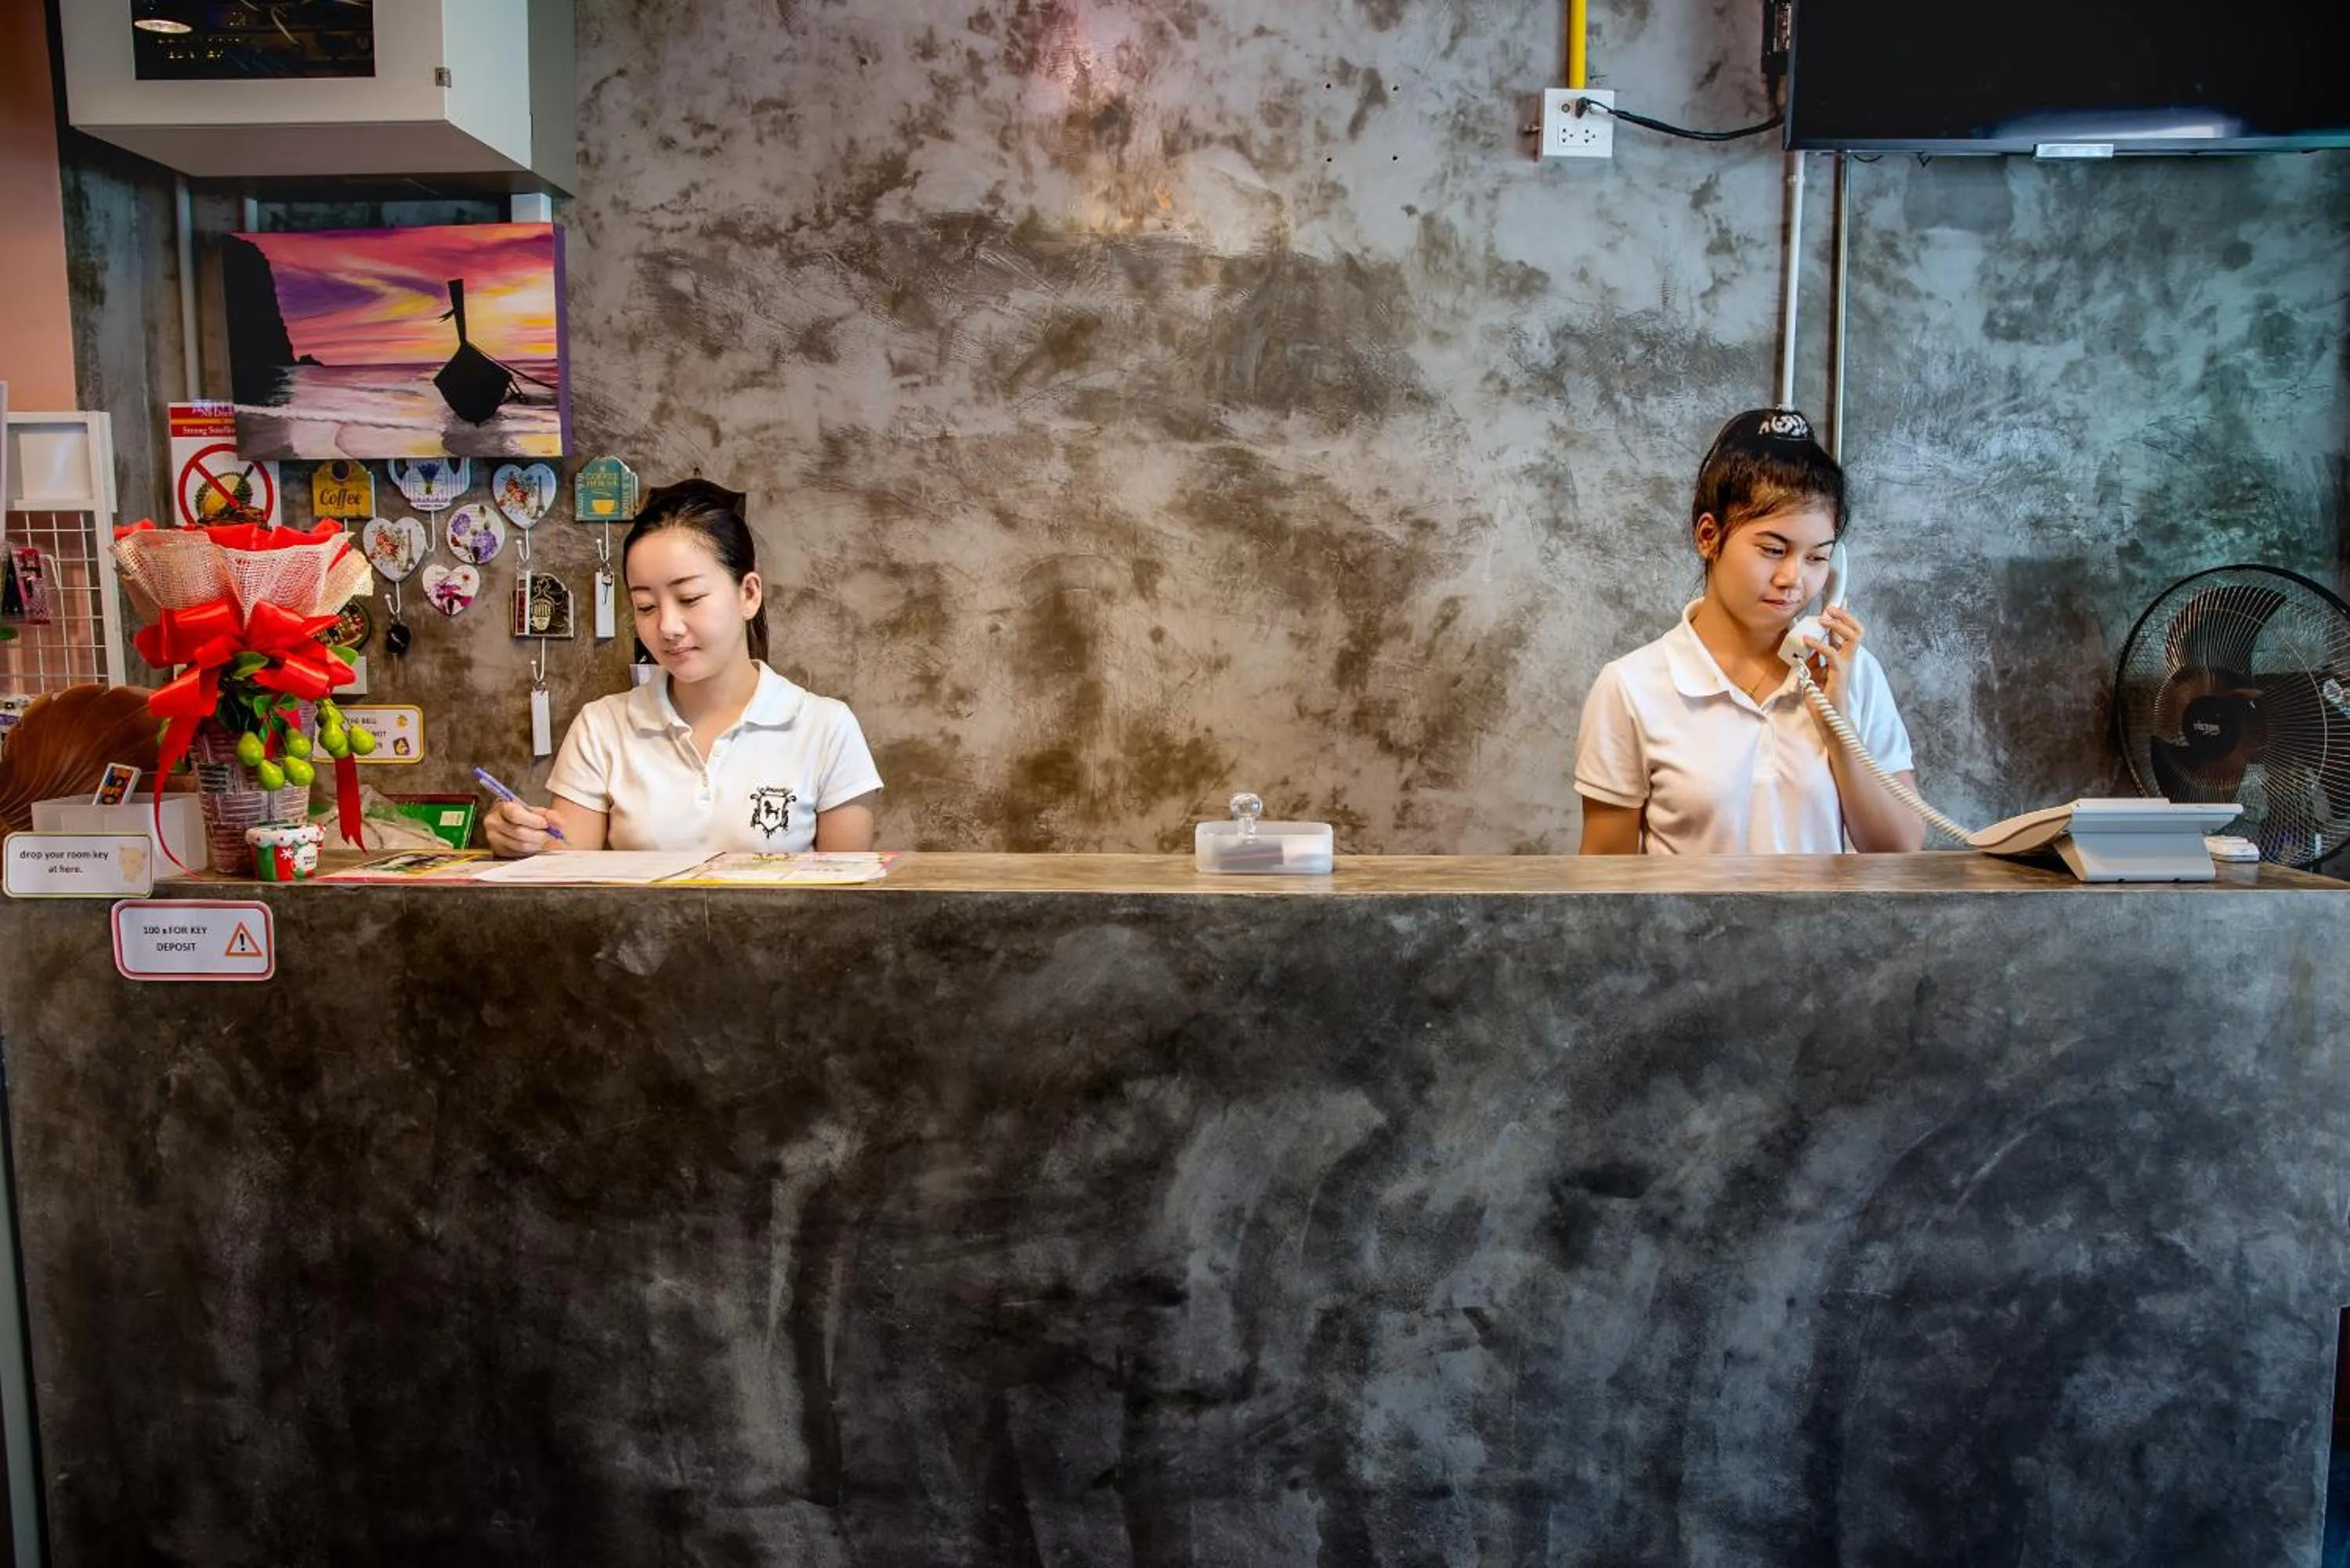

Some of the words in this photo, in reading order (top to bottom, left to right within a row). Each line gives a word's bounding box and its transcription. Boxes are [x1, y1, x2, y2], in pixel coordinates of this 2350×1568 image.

[320, 488, 362, 510] Coffee
[20, 851, 43, 860] drop
[45, 851, 65, 860] your
[92, 851, 109, 861] key
[156, 942, 197, 952] DEPOSIT
